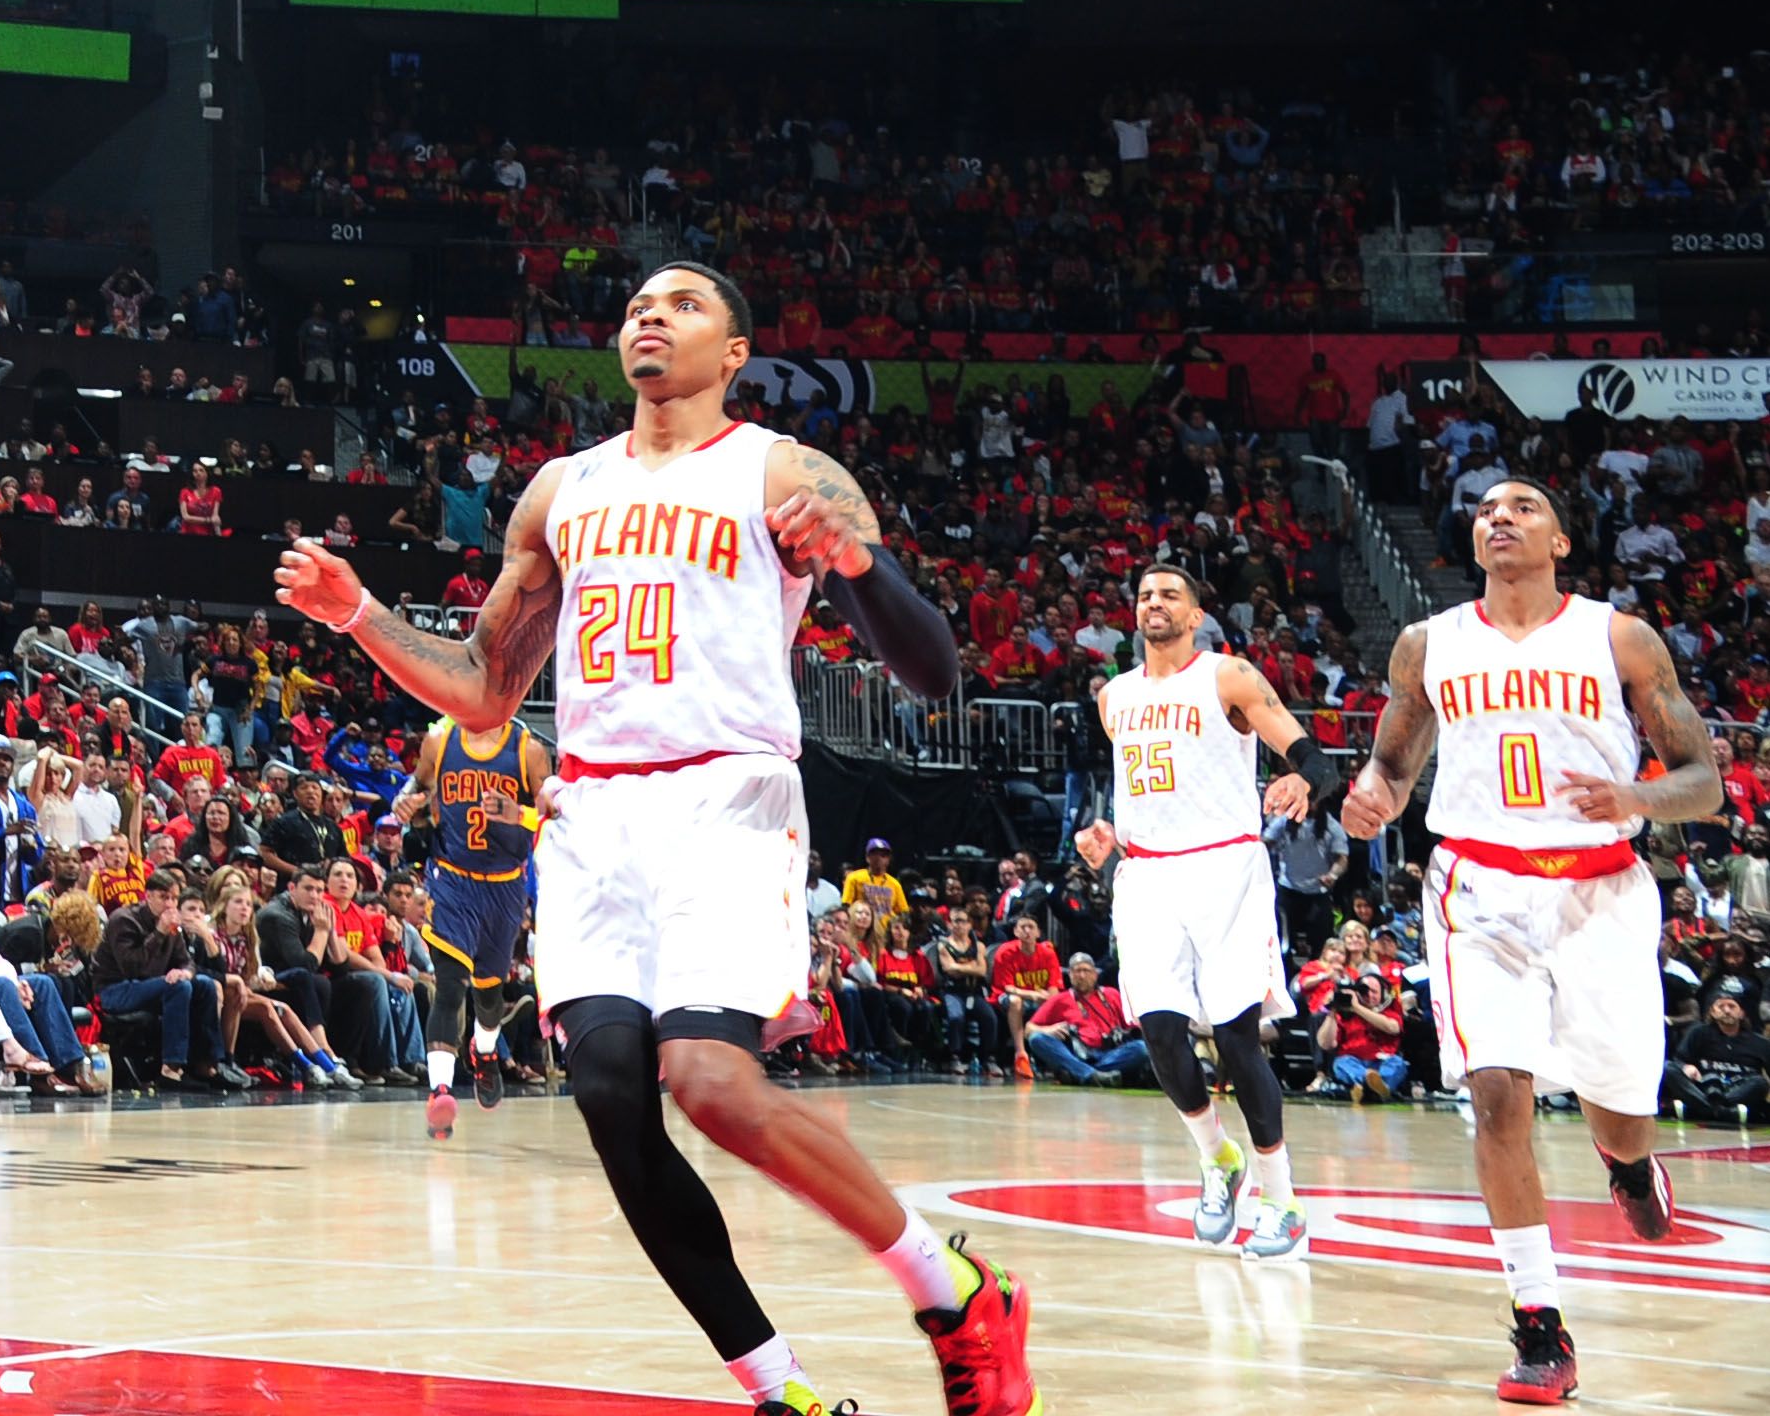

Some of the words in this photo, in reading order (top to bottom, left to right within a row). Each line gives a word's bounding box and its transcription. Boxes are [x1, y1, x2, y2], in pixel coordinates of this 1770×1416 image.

[331, 224, 363, 240] 201
[1671, 232, 1765, 252] 202-203
[397, 358, 435, 376] 108
[1642, 366, 1731, 385] WIND
[1675, 389, 1737, 402] CASINO
[557, 502, 742, 582] ATLANTA
[577, 582, 678, 684] 24
[1440, 669, 1602, 725] ATLANTA
[1109, 704, 1201, 739] ATLANTA
[441, 769, 519, 805] CAVS
[1122, 741, 1175, 797] 25
[1499, 732, 1546, 808] 0
[467, 806, 487, 850] 2
